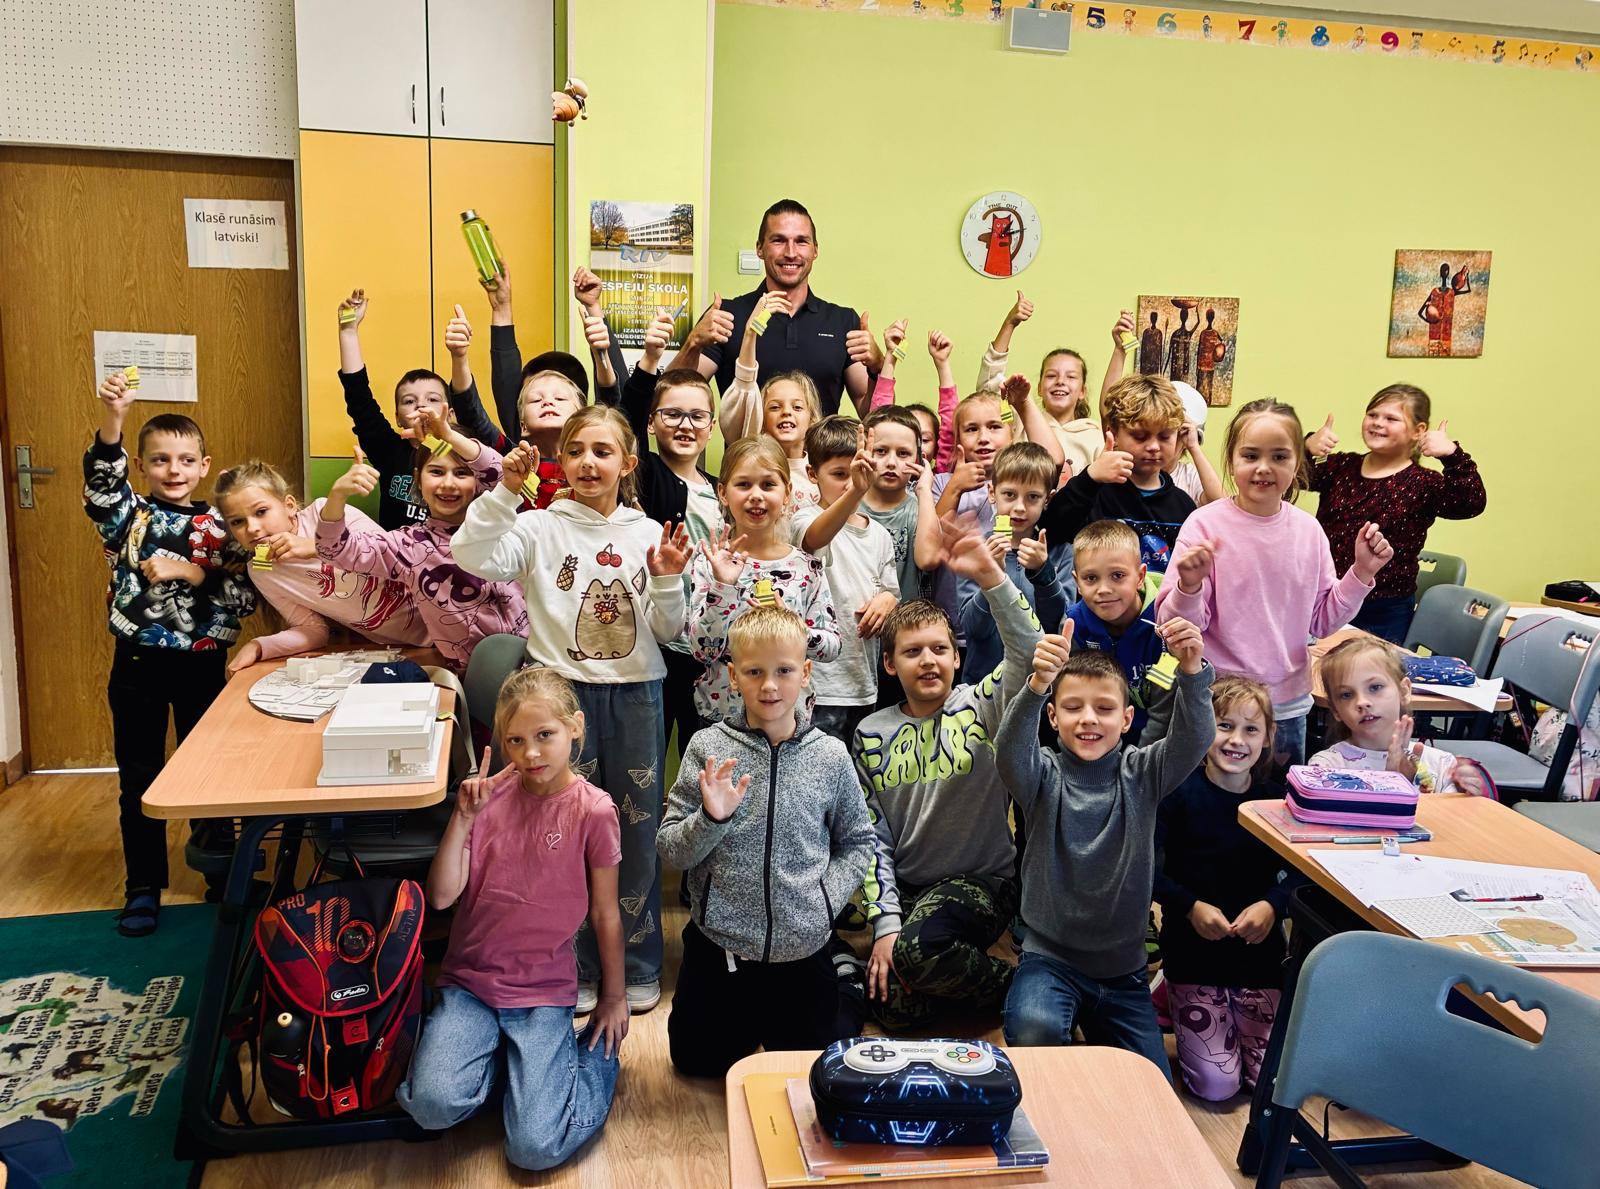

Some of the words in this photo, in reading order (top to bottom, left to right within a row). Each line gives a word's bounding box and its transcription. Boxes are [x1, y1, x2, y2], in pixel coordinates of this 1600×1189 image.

[1086, 7, 1106, 30] 5
[1157, 12, 1177, 34] 6
[1238, 19, 1257, 40] 7
[1310, 25, 1330, 47] 8
[1380, 31, 1399, 51] 9
[195, 211, 226, 224] Klasē
[229, 214, 276, 226] runāsim
[214, 231, 259, 243] latviski!
[601, 281, 645, 292] ESPĒJU
[649, 283, 688, 295] SKOLA
